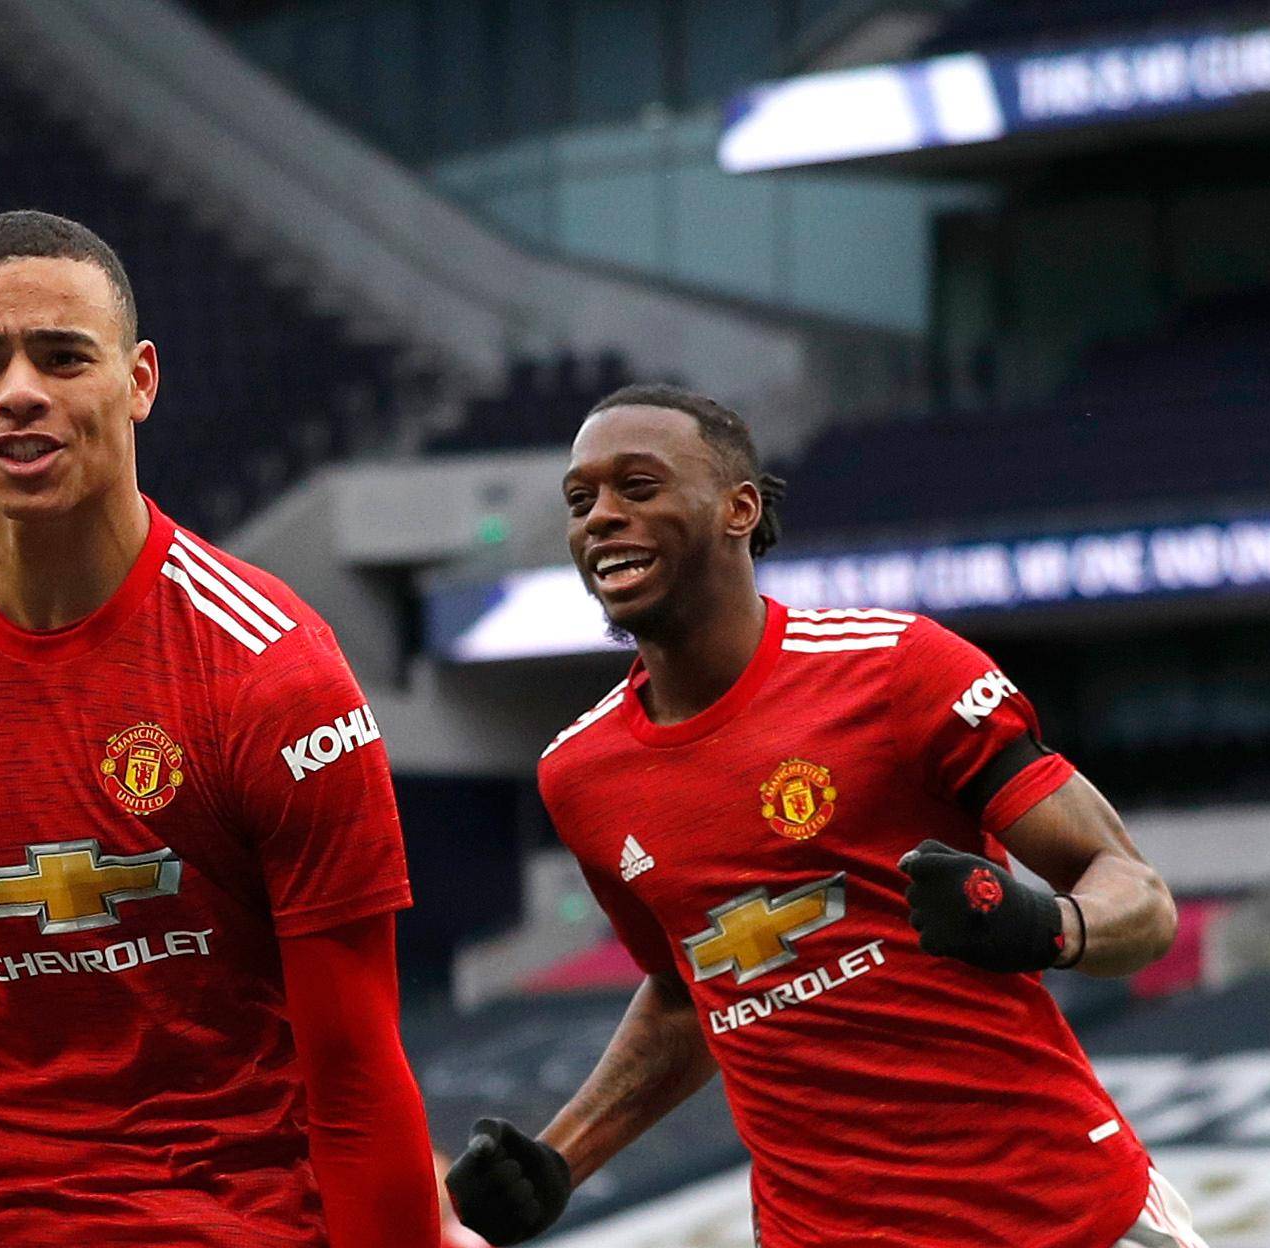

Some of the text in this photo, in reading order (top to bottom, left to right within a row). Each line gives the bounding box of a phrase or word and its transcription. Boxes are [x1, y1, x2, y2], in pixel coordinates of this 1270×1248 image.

[112, 728, 179, 765] MANCHESTER
[115, 789, 164, 810] UNITED
[709, 938, 886, 1035] CHEVROLET
